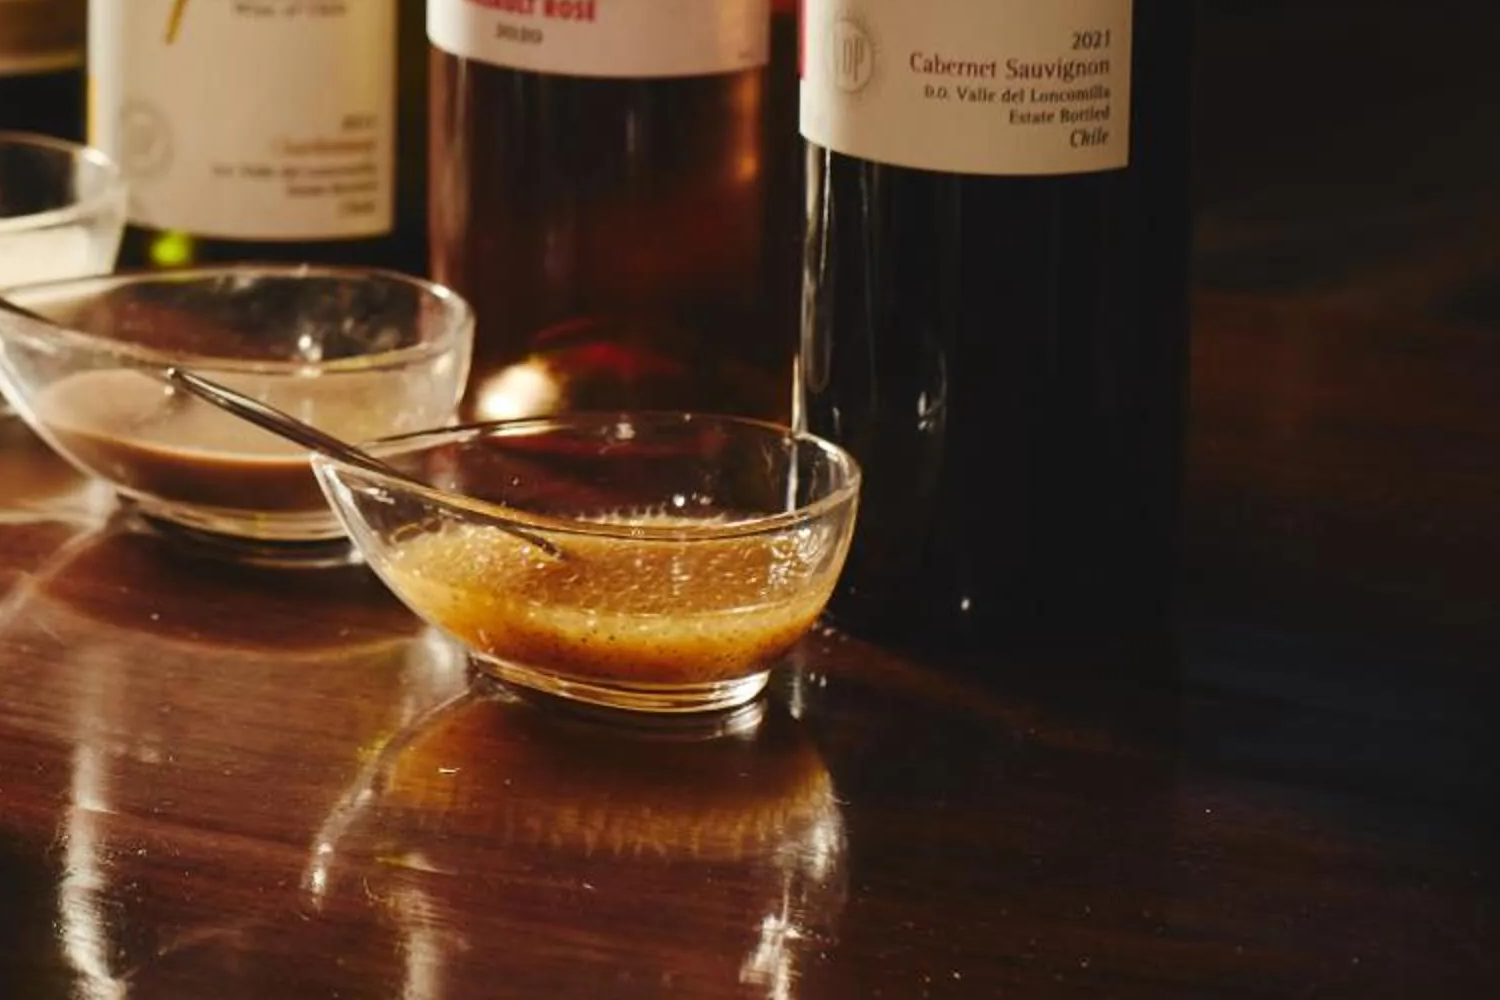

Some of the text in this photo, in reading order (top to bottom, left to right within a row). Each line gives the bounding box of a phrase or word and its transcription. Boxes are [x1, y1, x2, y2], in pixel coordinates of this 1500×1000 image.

[1071, 29, 1111, 51] 2021
[909, 51, 1110, 82] Cabernet Sauvignon
[956, 86, 997, 103] Valle
[1002, 87, 1025, 103] del
[1030, 83, 1112, 103] Loncomilla
[1009, 104, 1111, 126] Estate Bottled
[1069, 127, 1109, 149] Chile
